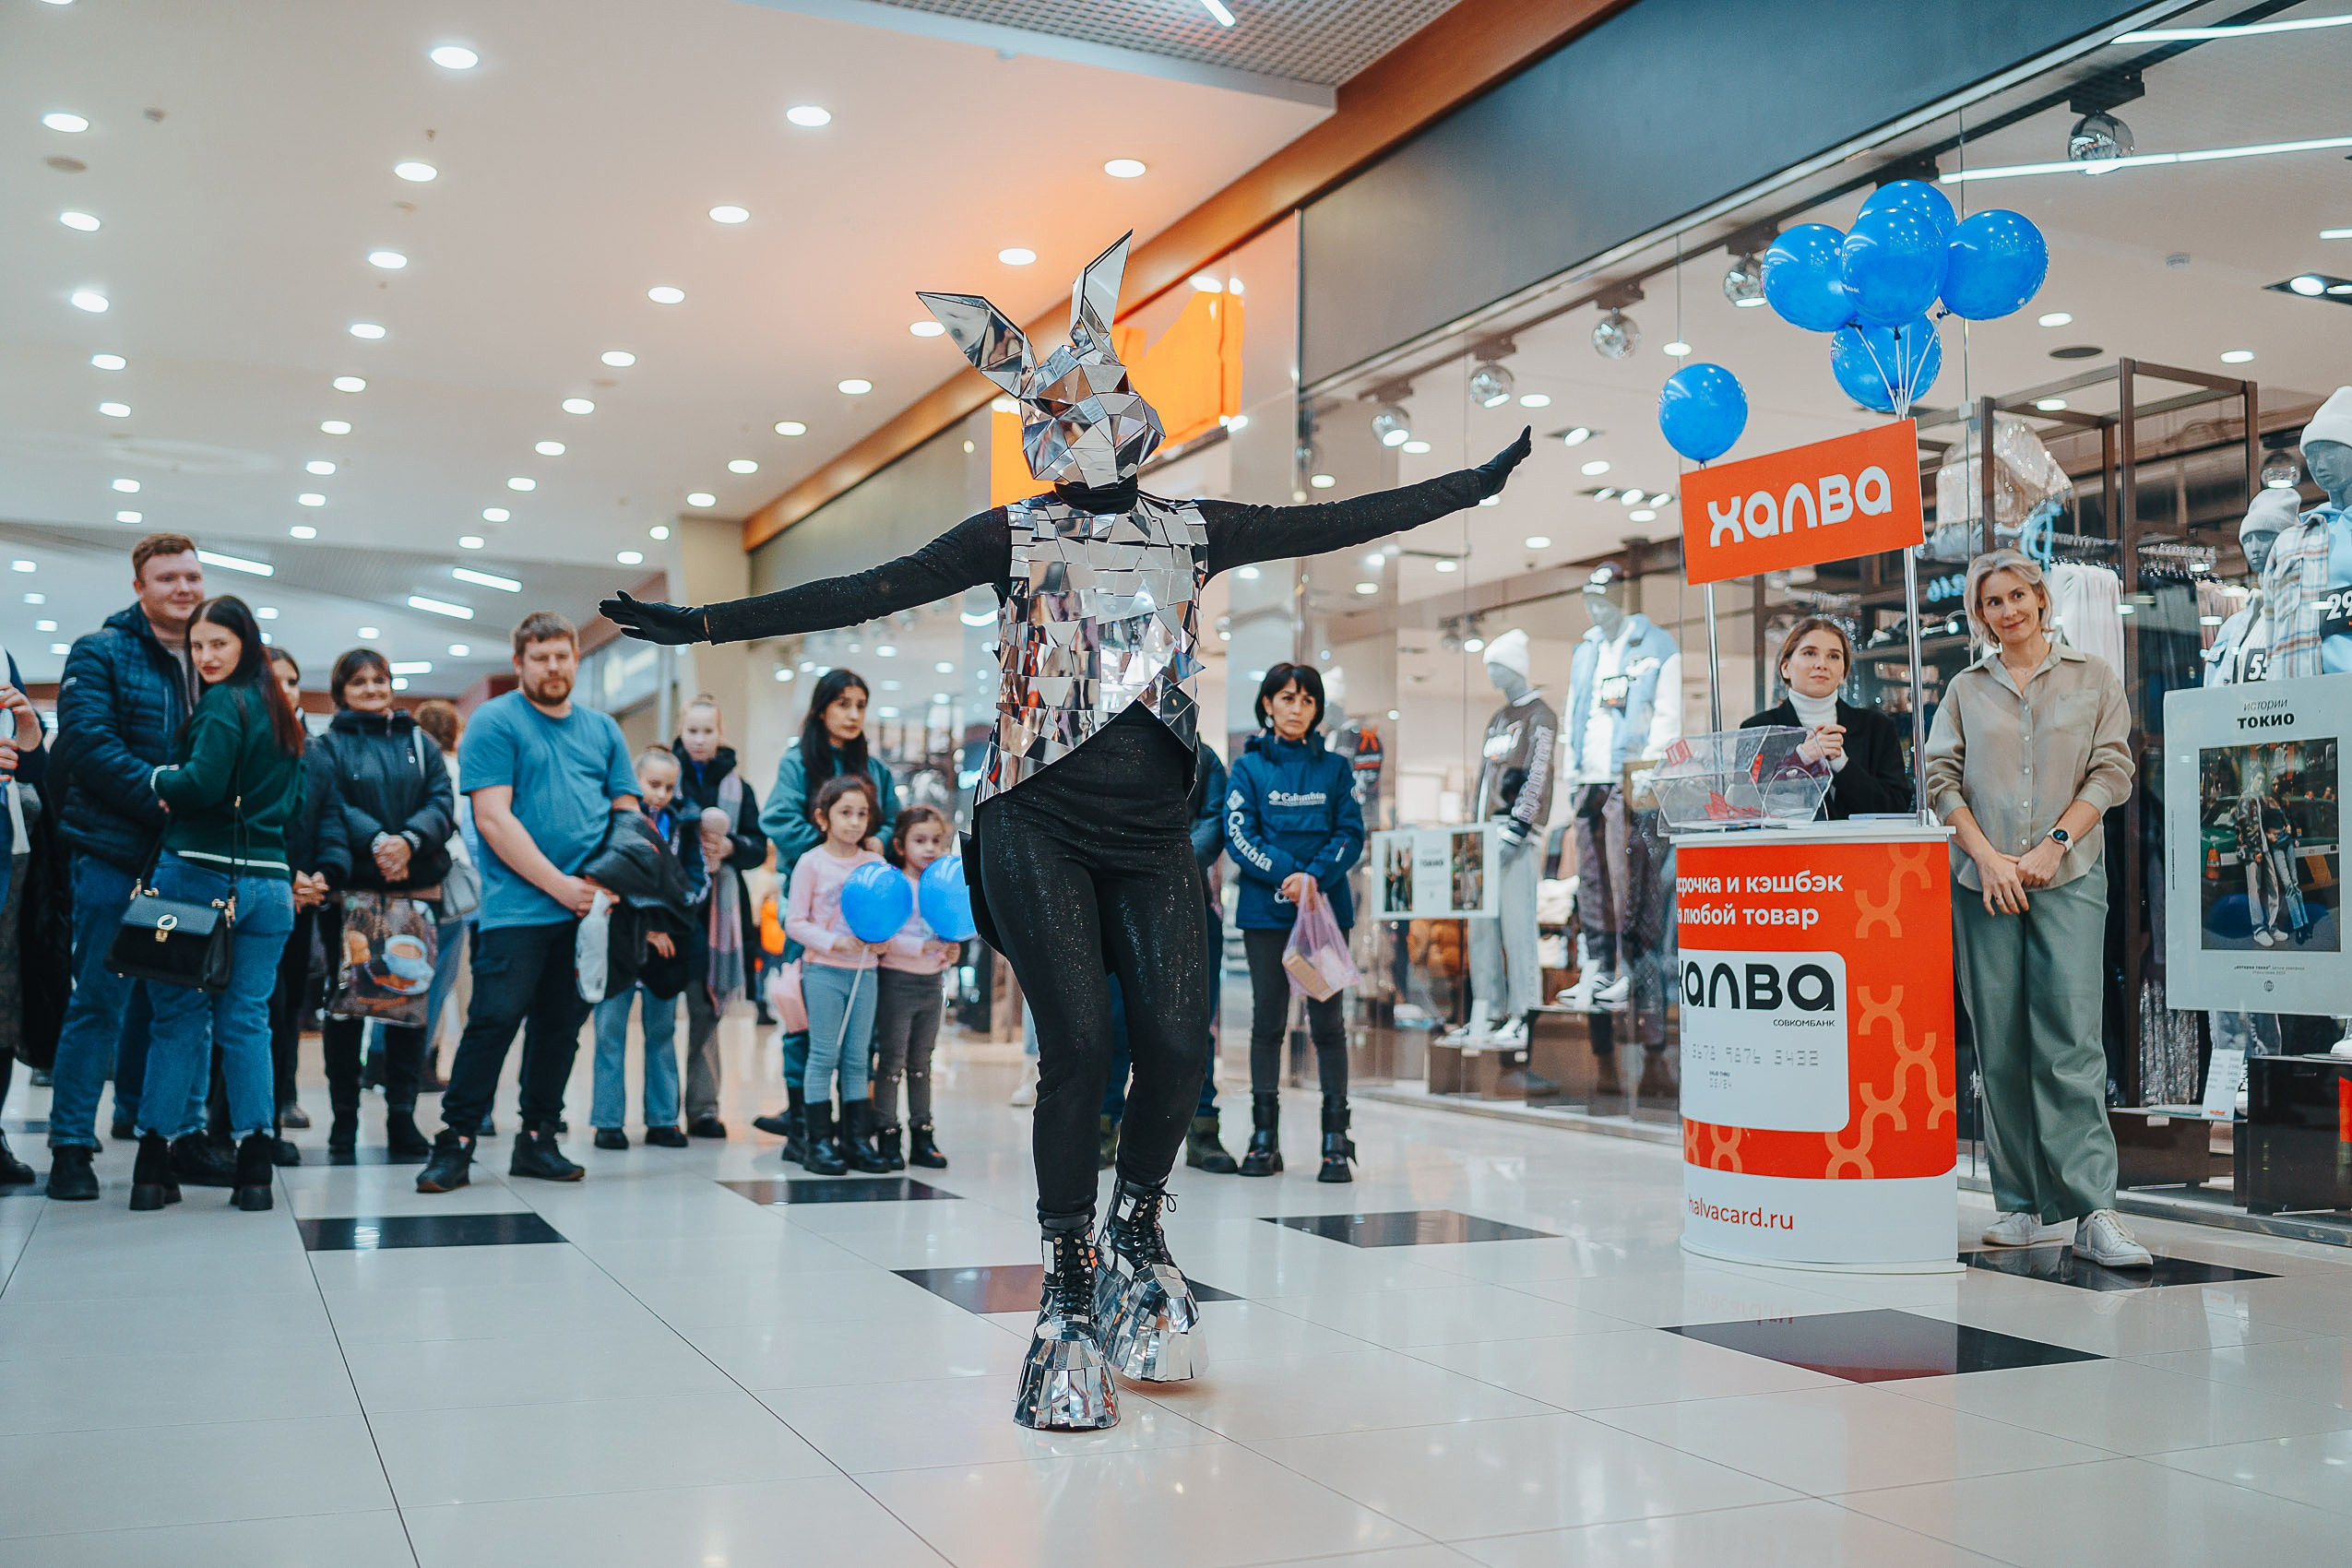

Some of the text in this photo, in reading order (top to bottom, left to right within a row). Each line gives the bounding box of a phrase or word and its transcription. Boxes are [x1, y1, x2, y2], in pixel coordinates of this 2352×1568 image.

[2243, 698, 2288, 712] истории
[1727, 876, 1740, 894] и
[1746, 870, 1844, 893] кэшбэк
[1683, 903, 1736, 925] любой
[1742, 908, 1820, 930] товар
[1773, 1018, 1835, 1028] СОВКОМБАНК
[1688, 1194, 1794, 1230] halvacard.ru
